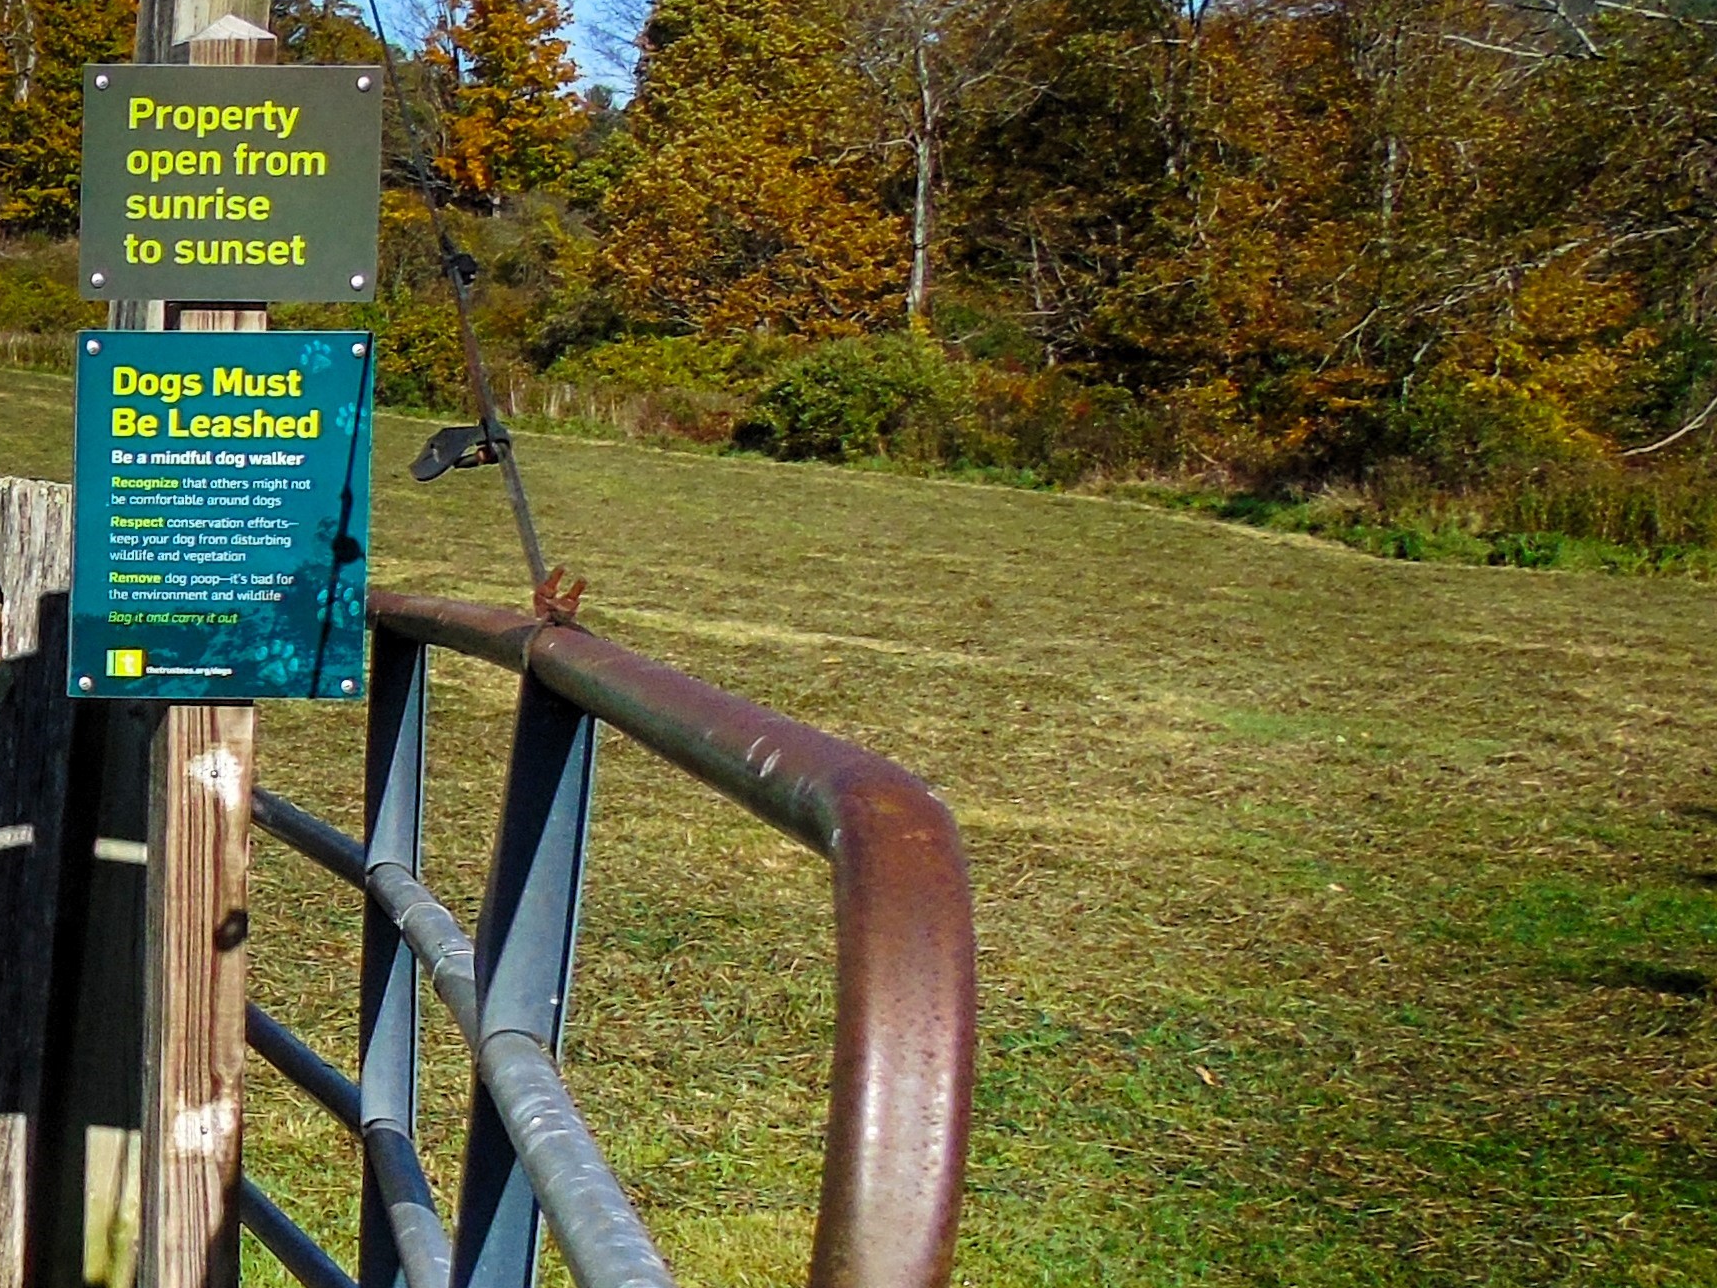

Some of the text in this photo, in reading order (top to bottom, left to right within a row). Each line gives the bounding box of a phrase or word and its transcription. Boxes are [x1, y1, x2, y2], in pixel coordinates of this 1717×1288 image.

[129, 97, 299, 138] Property
[126, 144, 325, 182] open from
[125, 187, 269, 220] sunrise
[123, 233, 305, 265] to sunset
[112, 366, 301, 402] Dogs Must
[111, 408, 319, 438] Be Leashed
[111, 449, 304, 467] Be a mindful dog walker
[111, 476, 310, 491] Recognize that others might not
[111, 493, 281, 508] be comfortable around dogs
[110, 516, 163, 529] Respect
[166, 517, 244, 528] conservation
[109, 532, 291, 547] keep your dog from disturbing
[109, 549, 245, 563] wildlife and vegetation
[108, 571, 161, 583] Remove
[164, 572, 187, 586] dog
[250, 573, 273, 584] bad
[276, 573, 293, 584] for
[108, 588, 281, 601] the environment and wildlife
[108, 611, 238, 626] Bag it and carry it out
